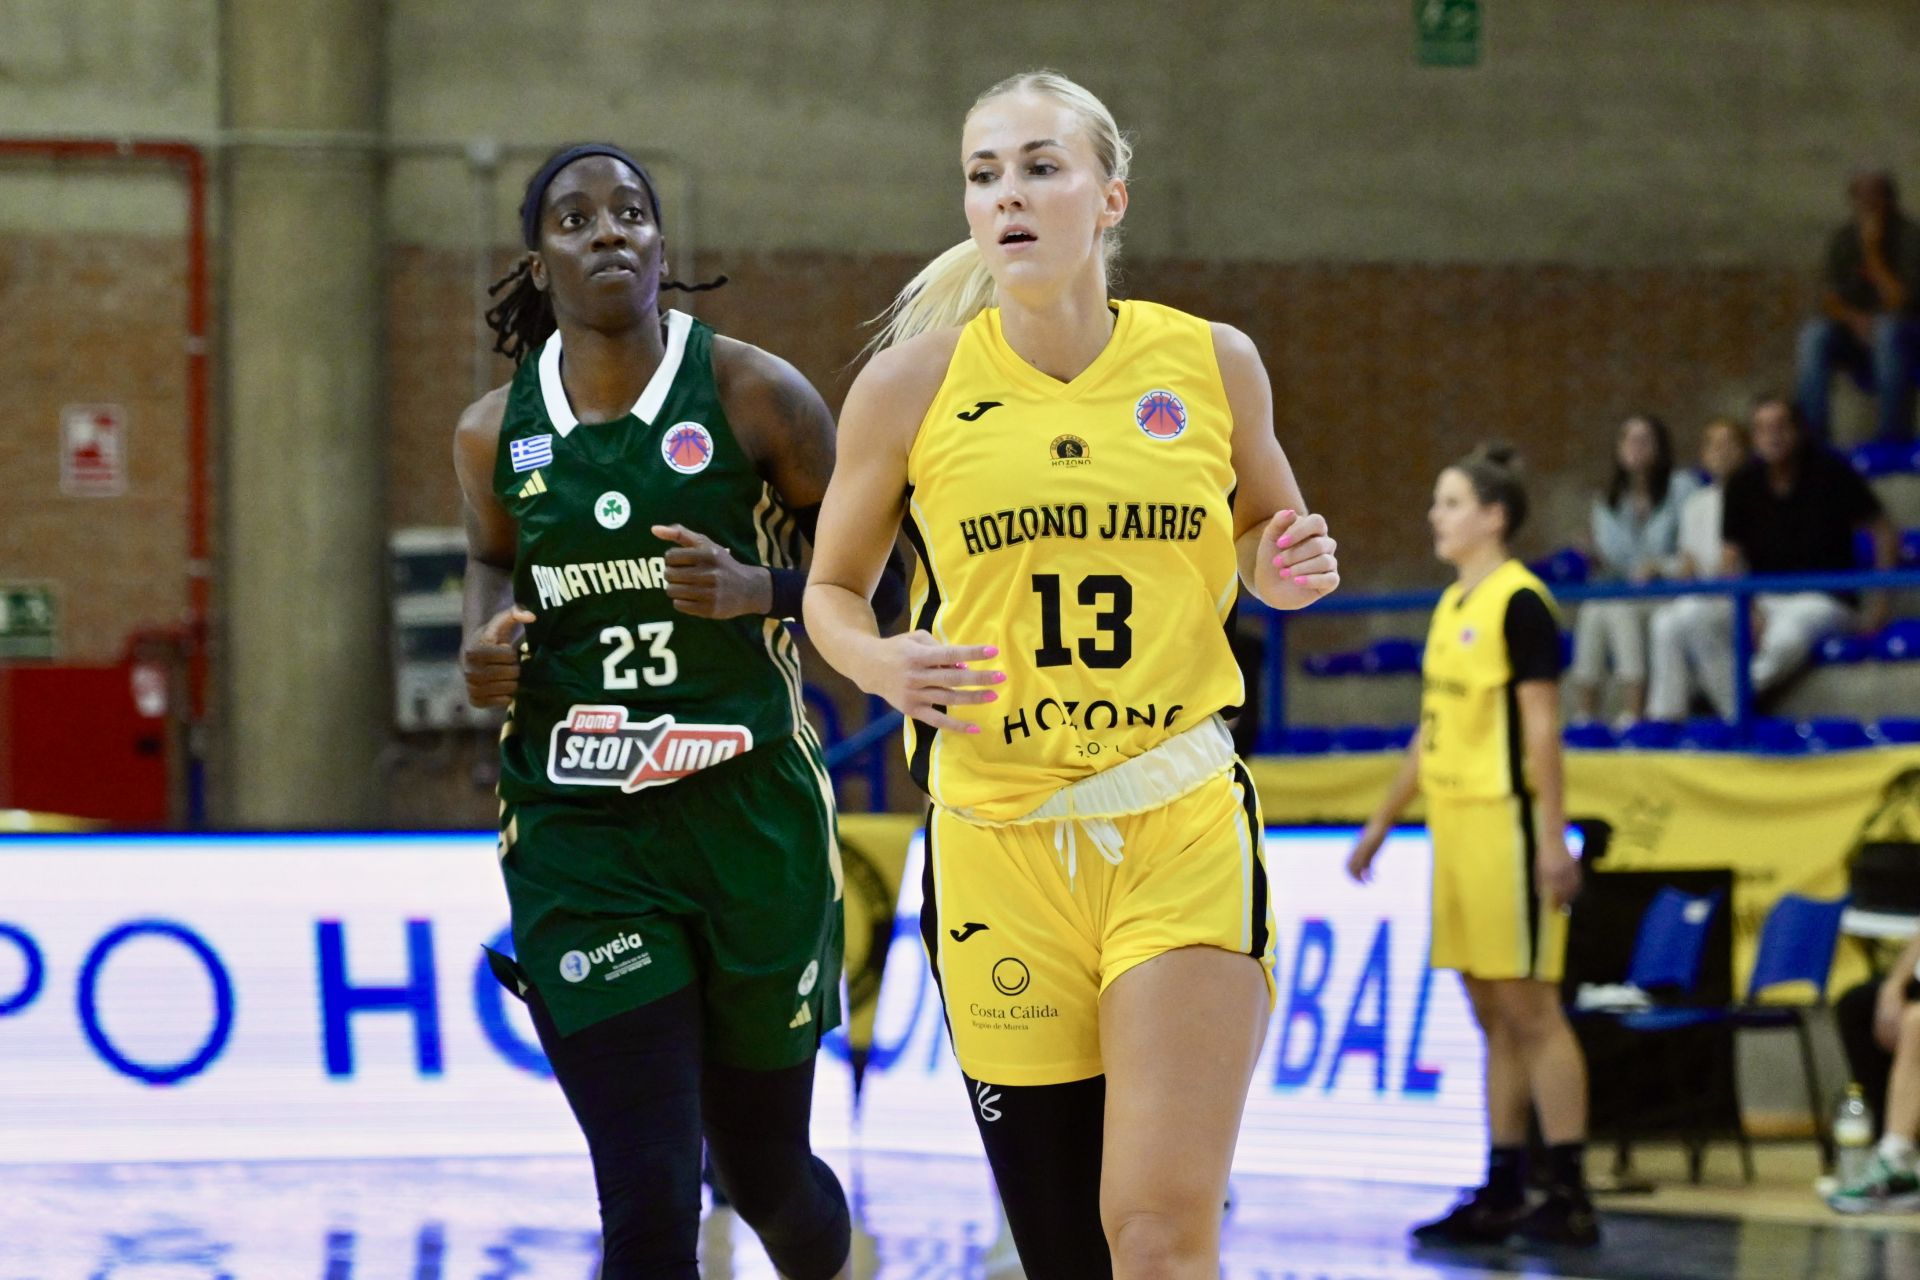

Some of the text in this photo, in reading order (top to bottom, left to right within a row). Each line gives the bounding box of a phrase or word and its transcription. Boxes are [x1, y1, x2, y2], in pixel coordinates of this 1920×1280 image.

[959, 502, 1208, 556] HOZONO JAIRIS
[1031, 573, 1133, 669] 13
[599, 620, 678, 690] 23
[969, 1003, 1059, 1020] Costa Cálida
